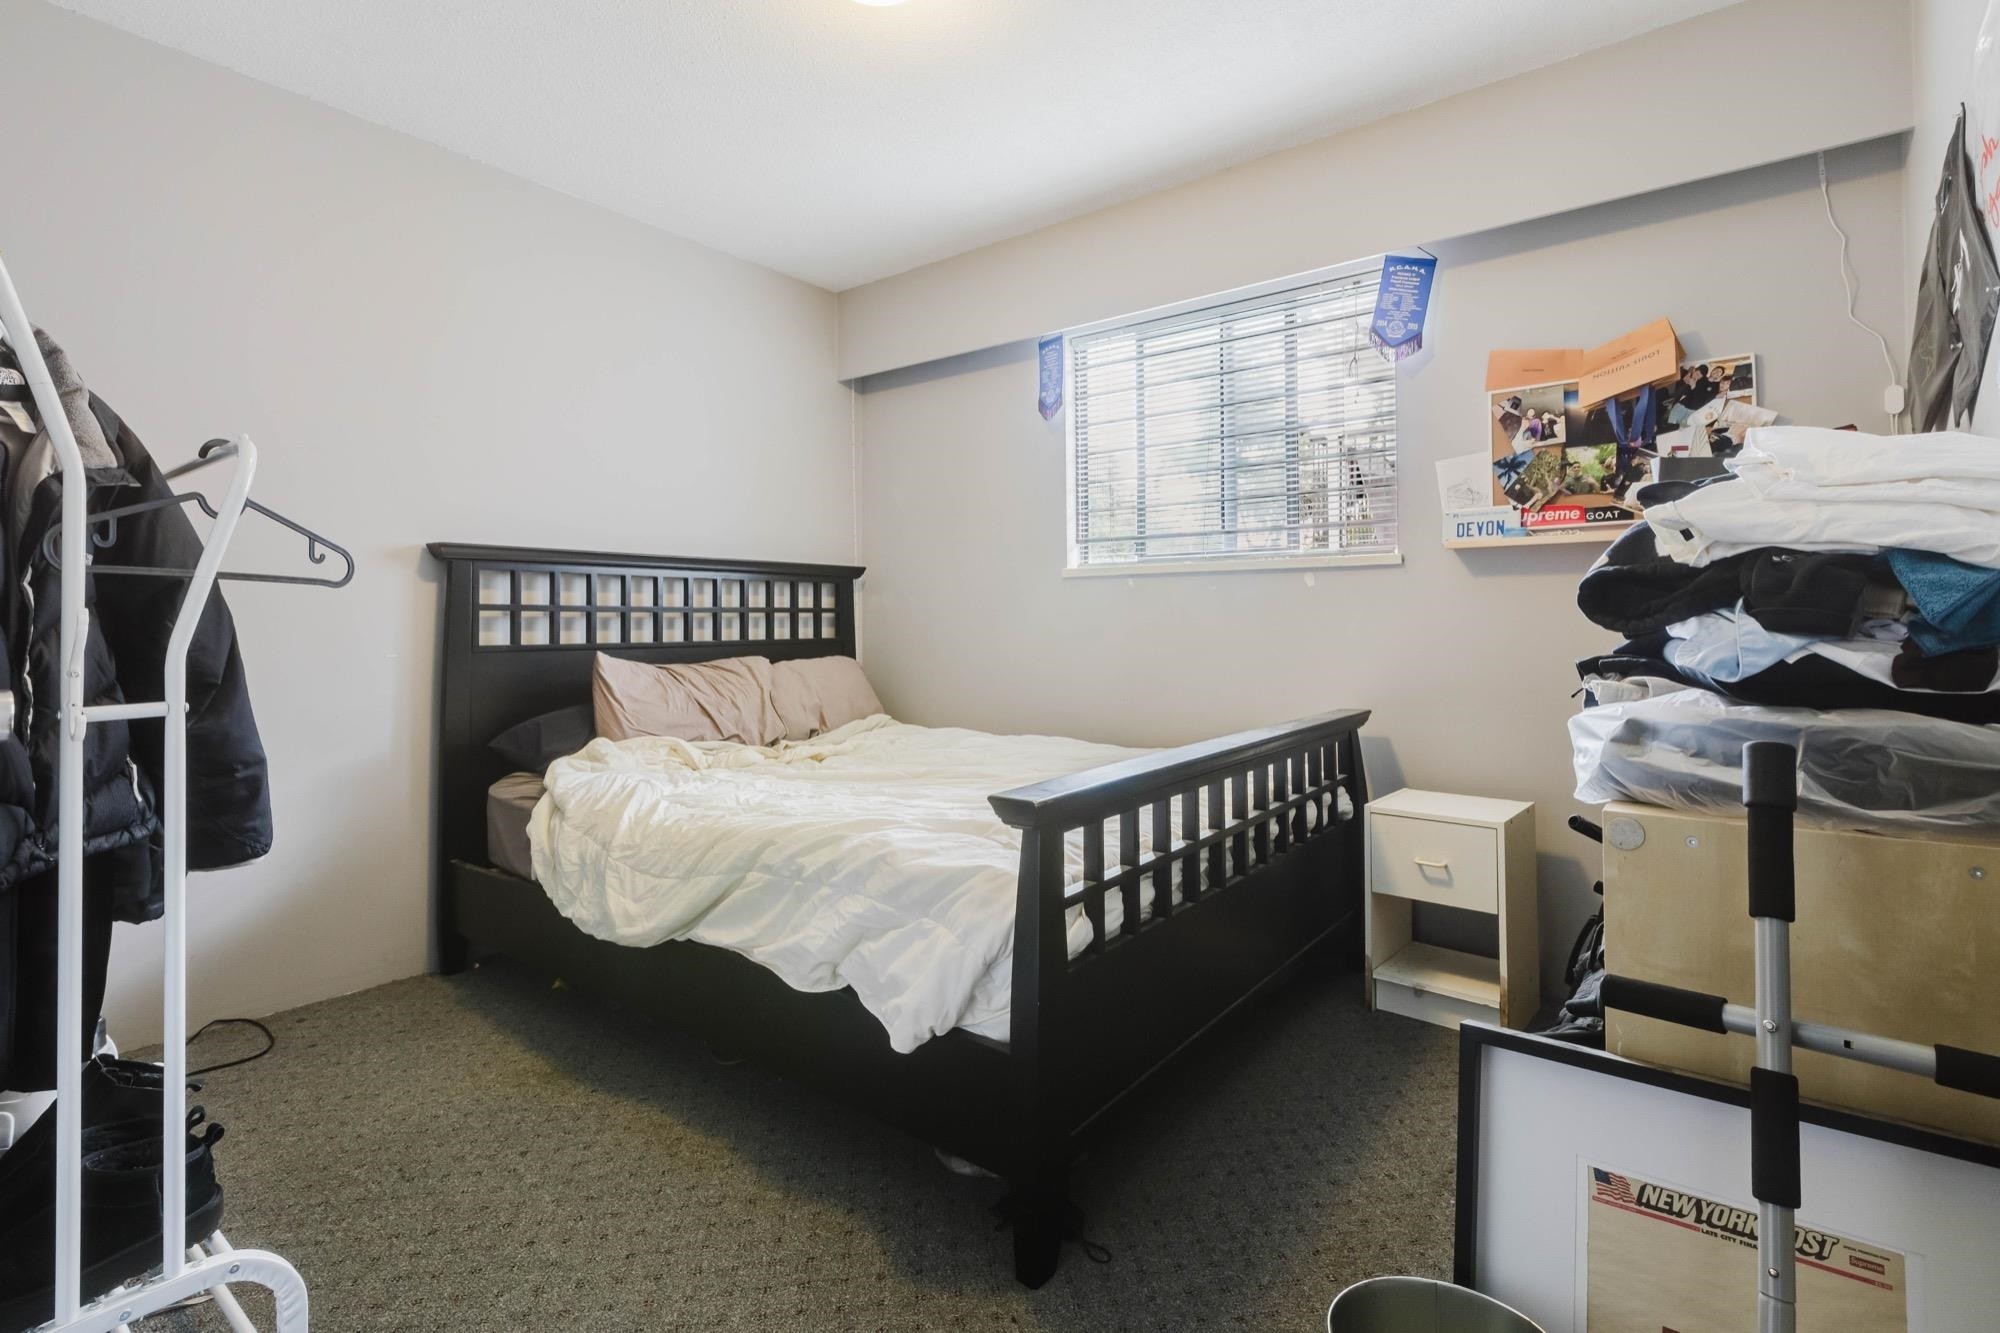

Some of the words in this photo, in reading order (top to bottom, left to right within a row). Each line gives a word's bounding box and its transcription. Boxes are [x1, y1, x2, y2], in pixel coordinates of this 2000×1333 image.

[1586, 510, 1620, 521] GOAT
[1456, 519, 1505, 538] DEVON
[1638, 1183, 1697, 1218] NEW
[1697, 1198, 1759, 1238] YORK
[1794, 1227, 1840, 1259] OST
[1701, 1227, 1718, 1238] LATE
[1720, 1232, 1737, 1244] CITY
[1739, 1239, 1759, 1250] FINA
